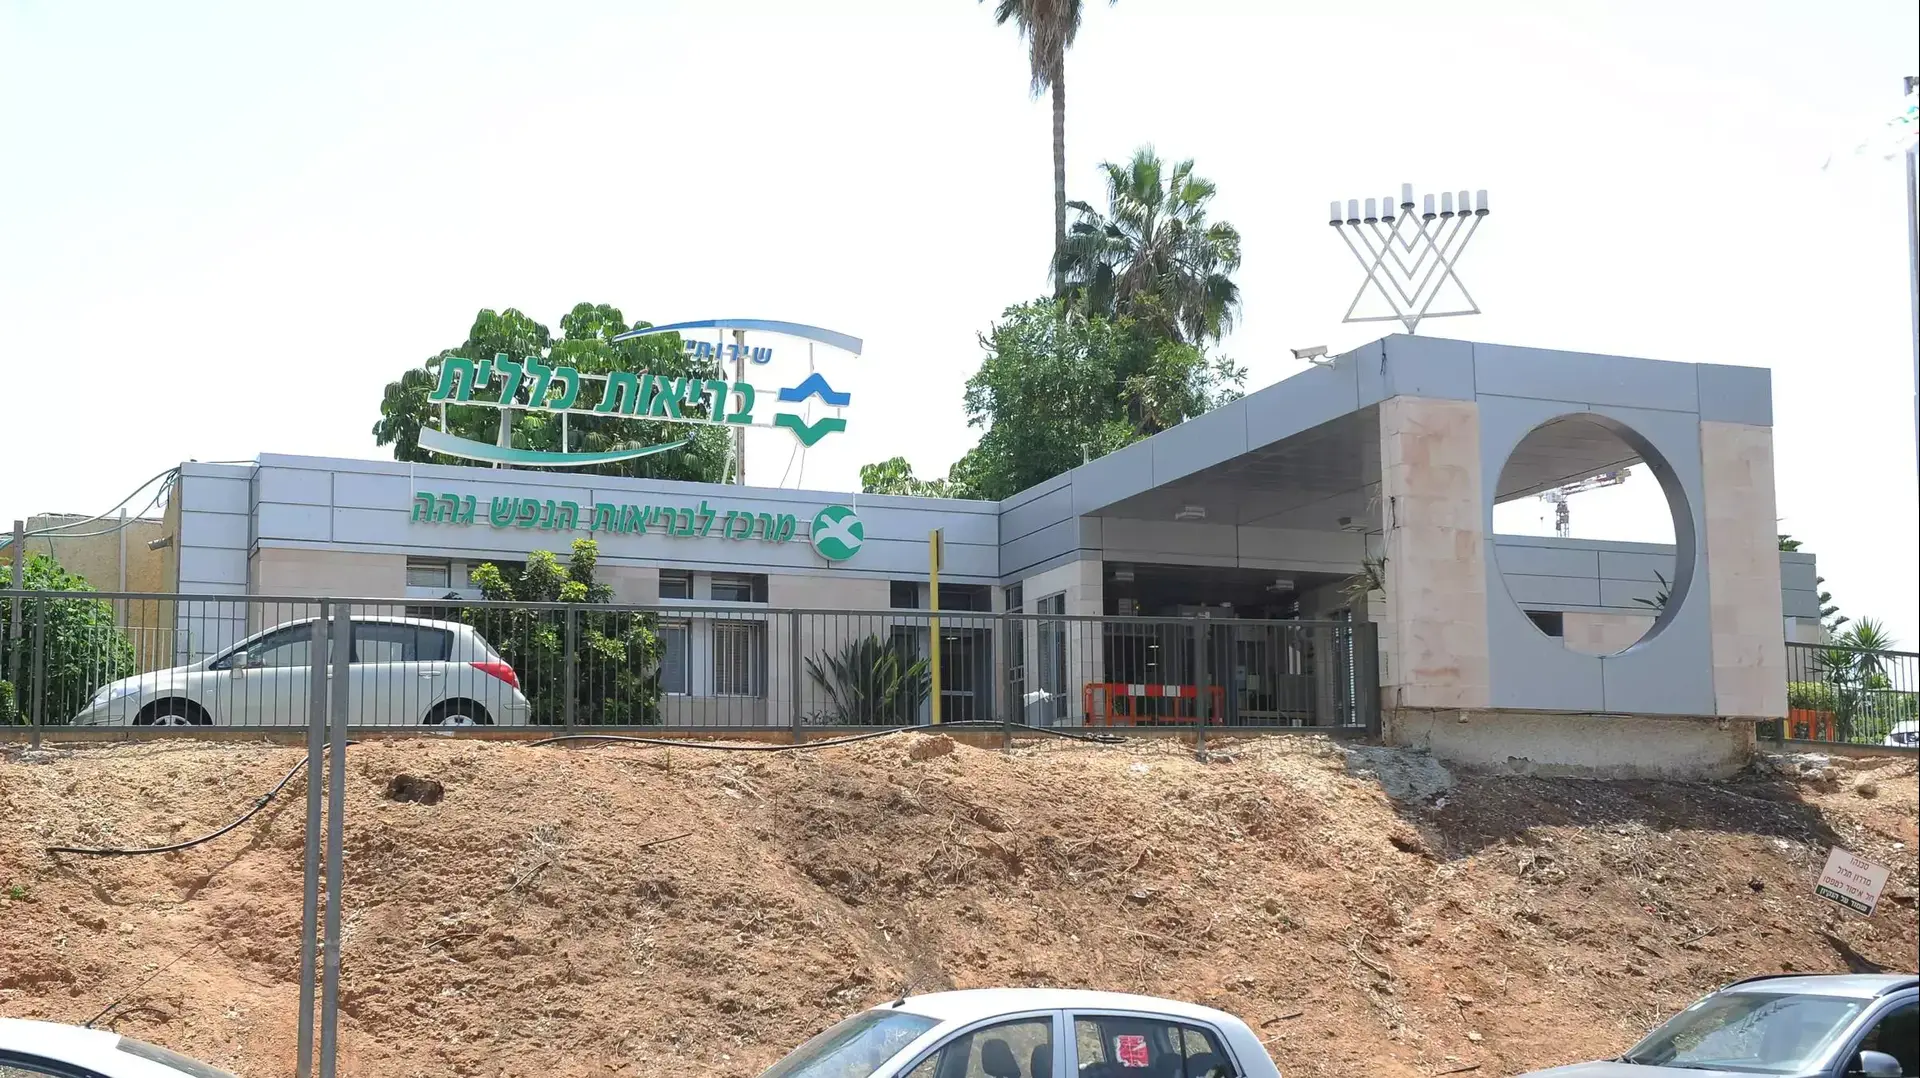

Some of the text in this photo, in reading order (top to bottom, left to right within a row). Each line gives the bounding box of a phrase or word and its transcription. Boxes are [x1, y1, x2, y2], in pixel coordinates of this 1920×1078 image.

[684, 339, 773, 365] שירותי
[428, 353, 756, 424] בריאות כללית
[411, 492, 796, 541] מרכז לבריאות הנפש גהה
[1837, 865, 1872, 887] מדרון תלול
[1846, 884, 1864, 898] איסור
[1866, 892, 1874, 902] חל
